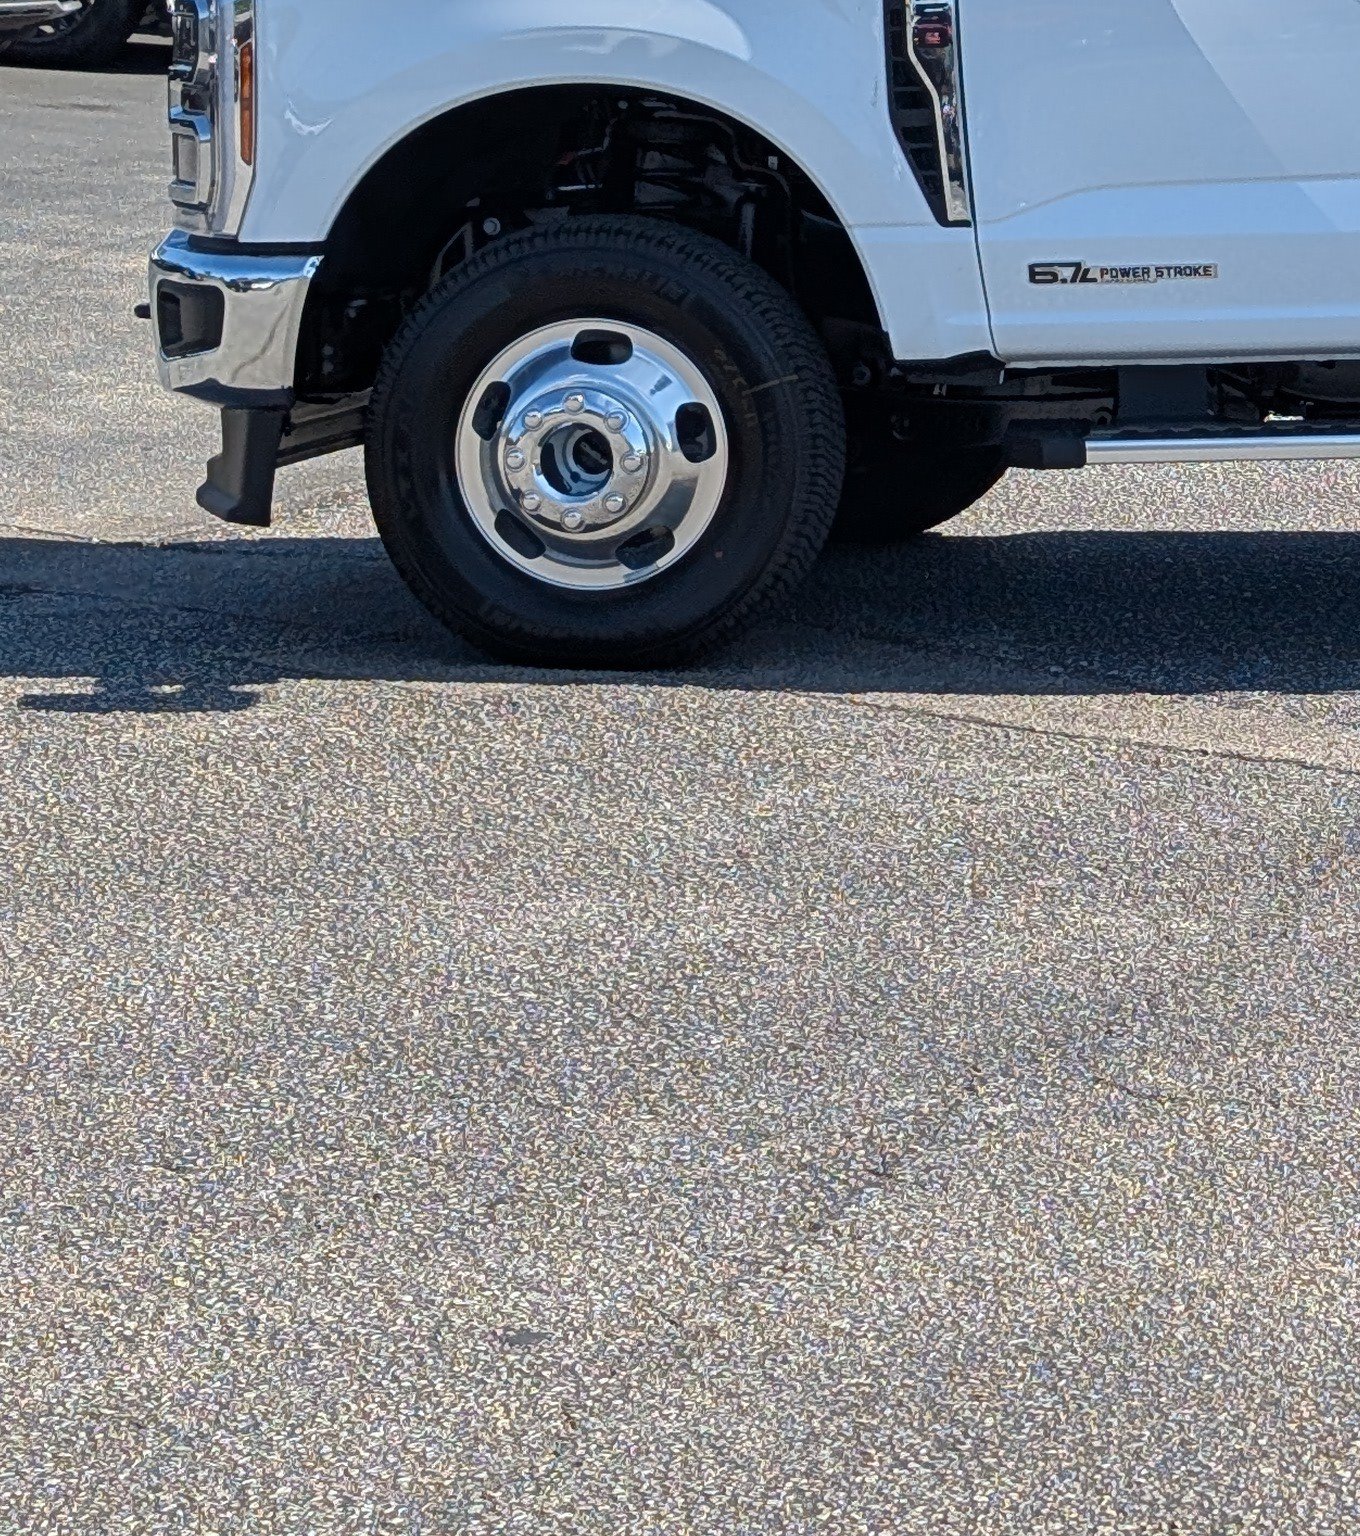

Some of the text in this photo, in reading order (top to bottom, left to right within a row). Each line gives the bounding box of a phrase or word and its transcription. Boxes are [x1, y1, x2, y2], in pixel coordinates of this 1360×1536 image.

[1028, 261, 1213, 285] 6.7L POWER STROKE
